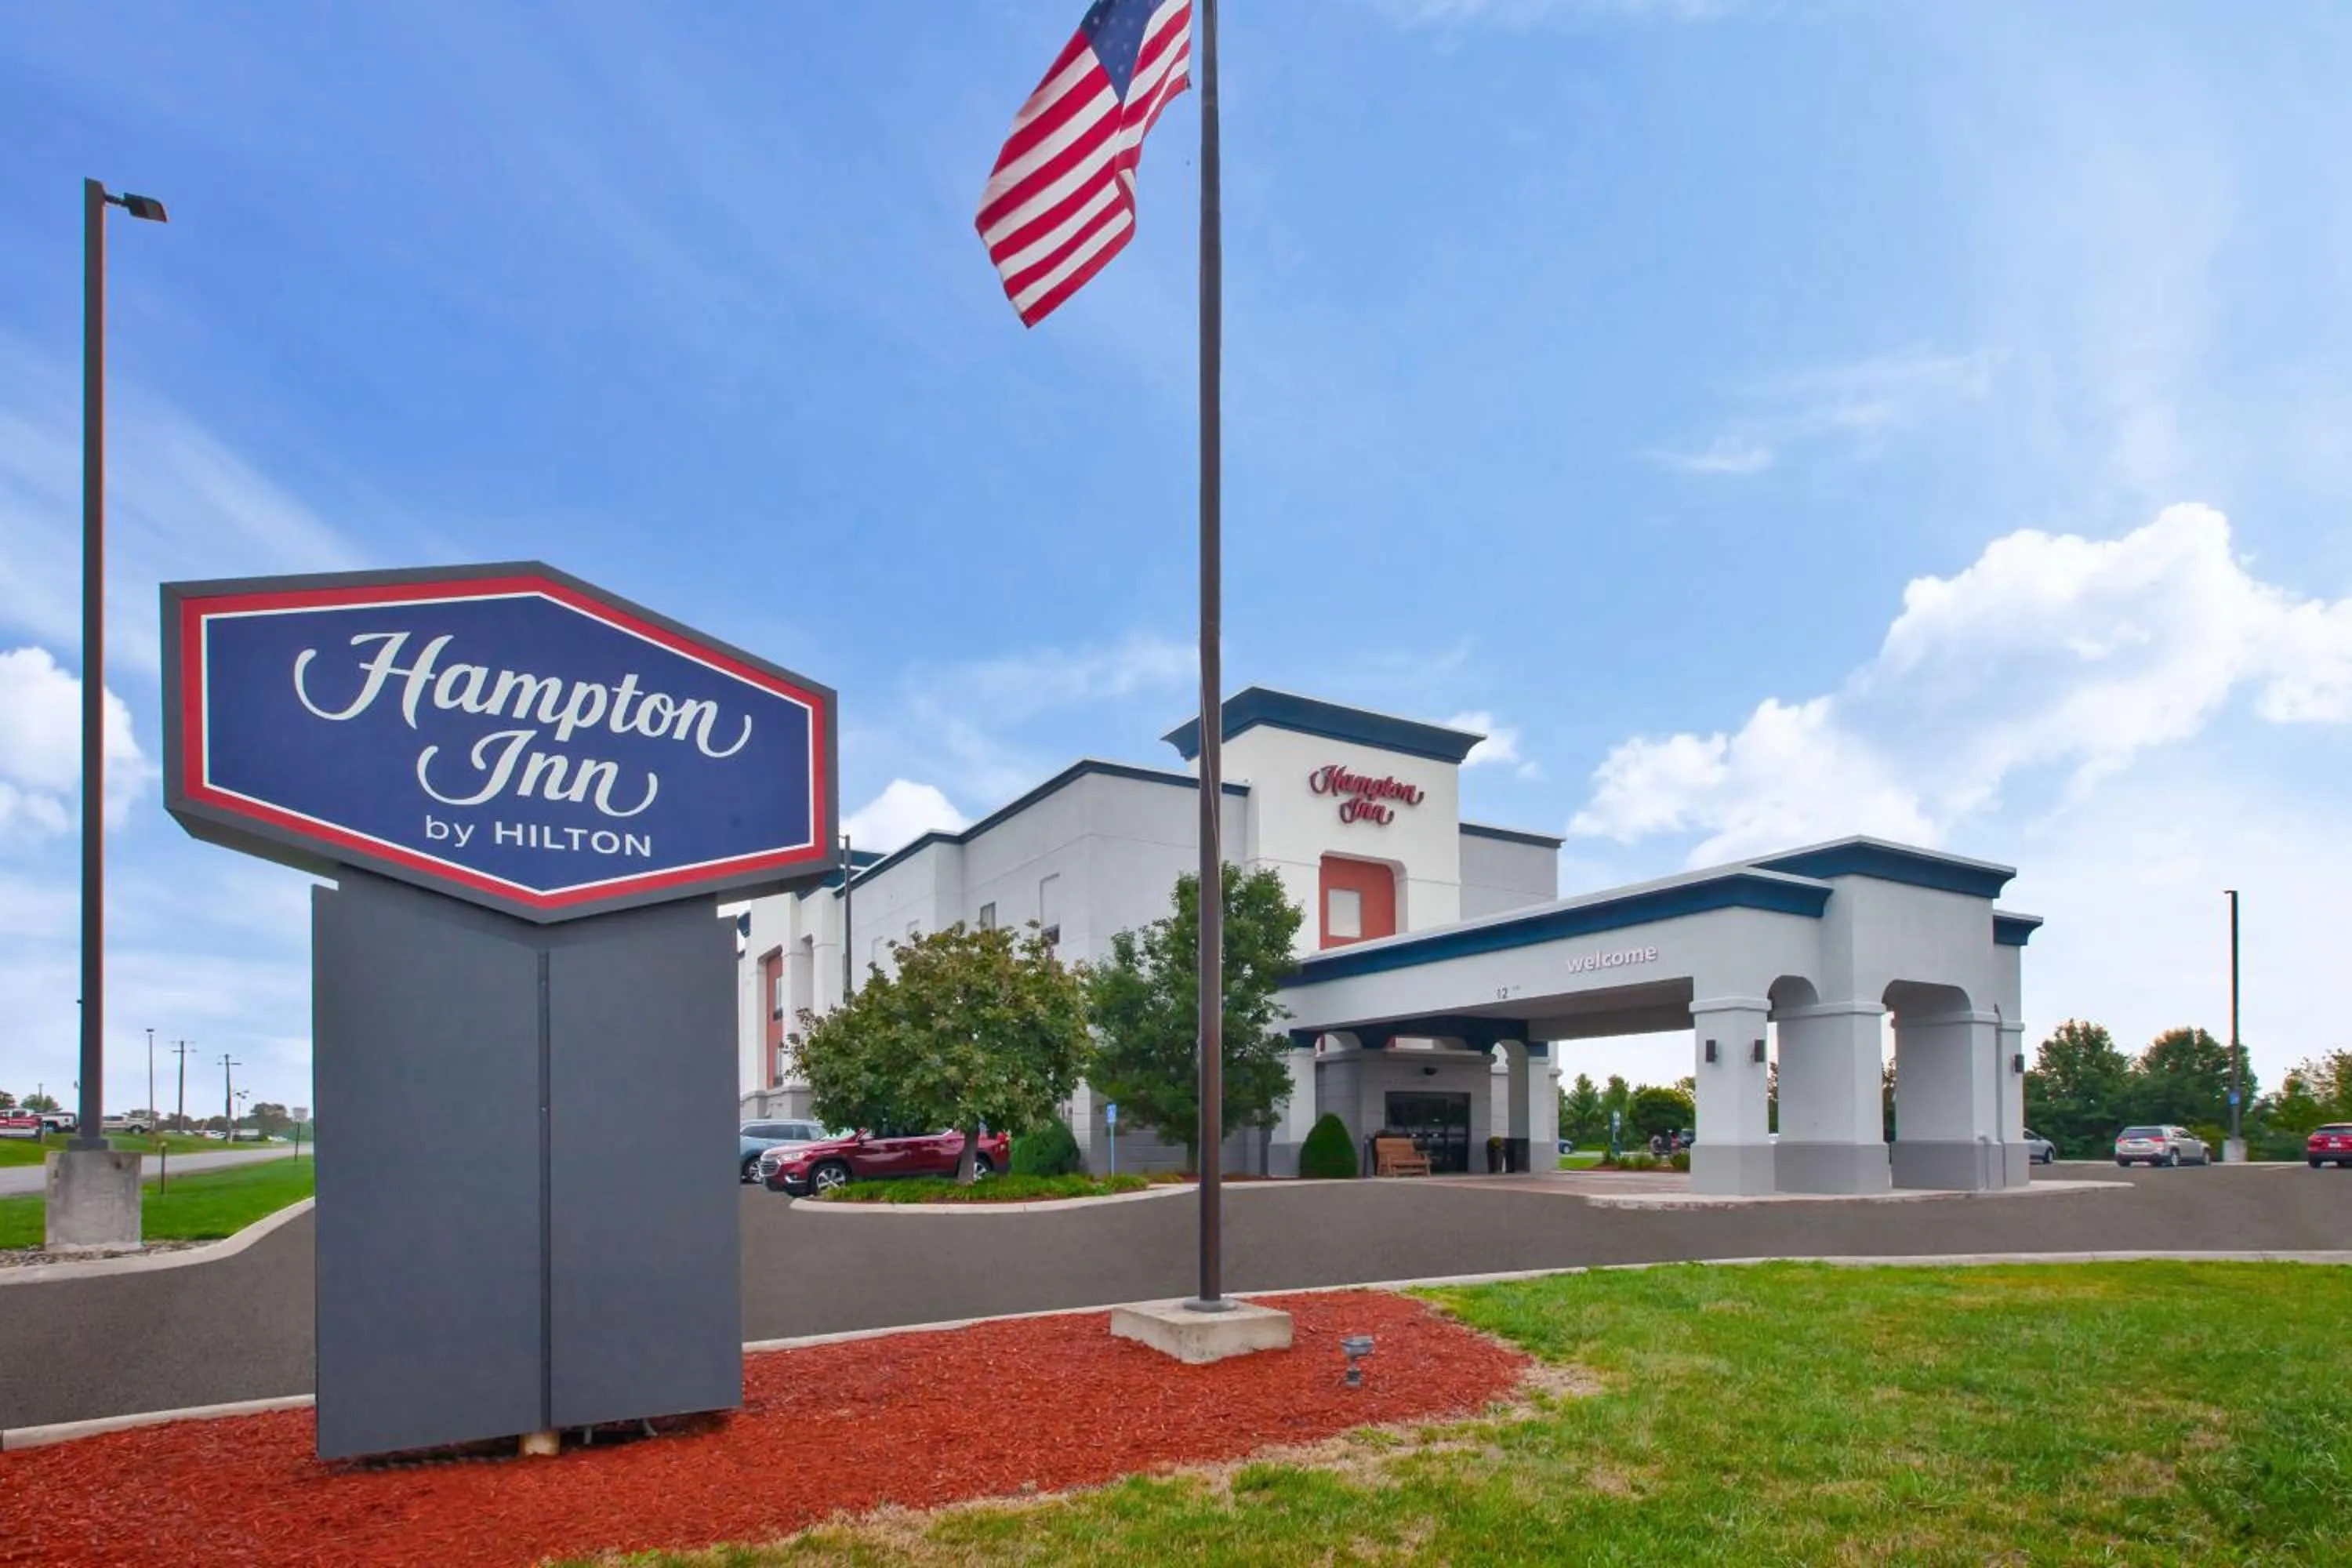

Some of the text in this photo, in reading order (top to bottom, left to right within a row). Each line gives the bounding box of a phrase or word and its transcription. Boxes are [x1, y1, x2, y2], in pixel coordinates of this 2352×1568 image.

[294, 632, 752, 758] Hampton
[416, 730, 659, 817] Inn
[1309, 765, 1425, 805] Hampton
[1340, 798, 1395, 825] Inn
[424, 815, 652, 857] by HILTON
[1567, 946, 1658, 974] welcome
